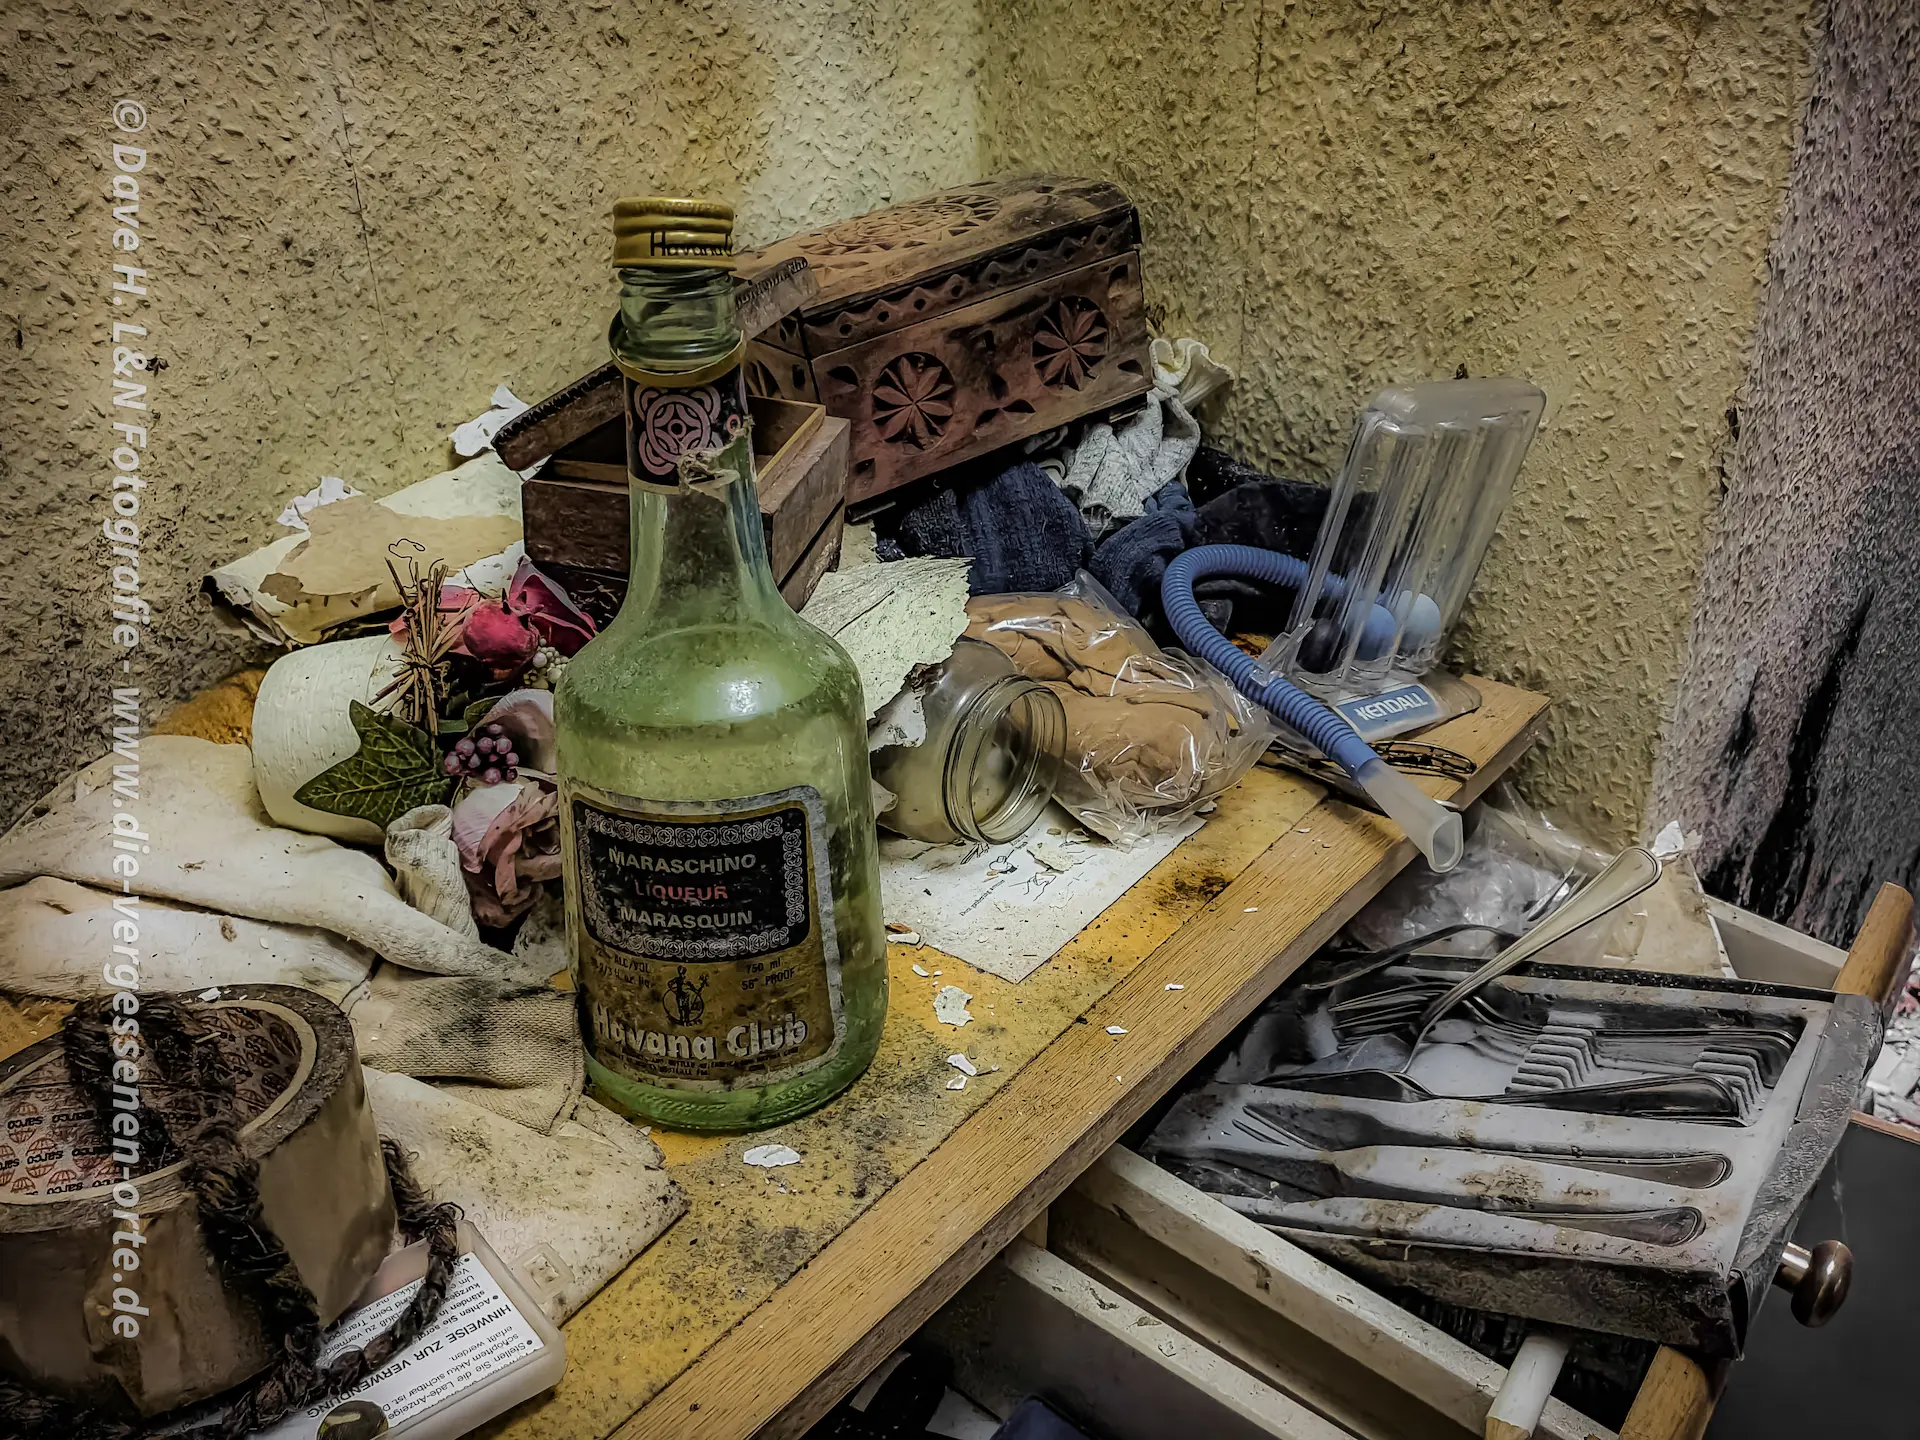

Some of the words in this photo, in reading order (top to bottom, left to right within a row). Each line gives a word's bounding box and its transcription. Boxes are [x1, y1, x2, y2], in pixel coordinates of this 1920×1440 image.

[1354, 692, 1428, 721] KENDALL
[607, 846, 757, 874] MARASCHINO
[634, 878, 729, 902] LIQUEUR
[619, 905, 753, 929] MARASQUIN
[745, 962, 764, 974] 750
[769, 956, 781, 970] ml
[764, 966, 796, 986] PROOF
[592, 1000, 717, 1061] Havana
[725, 1011, 808, 1058] Club
[7, 1116, 44, 1130] sarco
[27, 1150, 64, 1165] sarco
[458, 1275, 475, 1285] Um
[375, 1294, 391, 1307] nur
[450, 1289, 486, 1310] ständen
[459, 1297, 491, 1317] Achten
[369, 1305, 394, 1320] beim
[439, 1308, 450, 1317] in
[442, 1315, 459, 1326] Sie
[364, 1325, 378, 1334] zu
[445, 1304, 512, 1344] HINWEISE
[413, 1339, 444, 1361] ZUR
[448, 1340, 486, 1362] werden.
[494, 1341, 526, 1363] Stellen
[447, 1359, 471, 1375] Akku
[475, 1360, 492, 1373] Sie
[408, 1373, 446, 1398] sichtbar
[457, 1372, 472, 1383] die
[306, 1359, 412, 1418] VERWENDUNG
[388, 1380, 455, 1421] Lade-Anzeige
[391, 1393, 407, 1405] ist.
